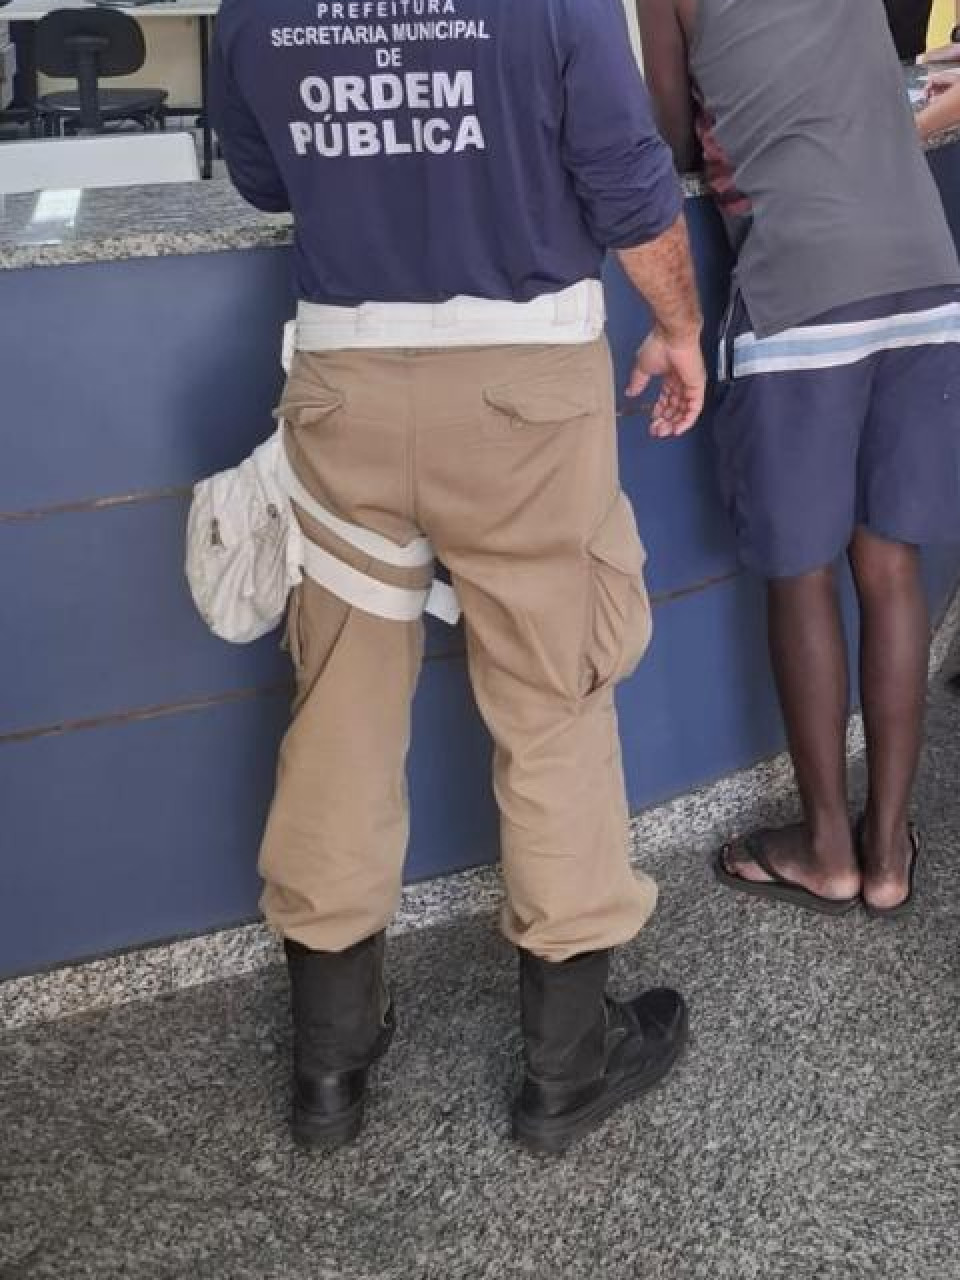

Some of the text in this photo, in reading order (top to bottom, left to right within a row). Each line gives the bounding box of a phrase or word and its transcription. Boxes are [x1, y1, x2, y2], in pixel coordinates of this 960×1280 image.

[270, 19, 491, 47] SECRETARIA MUNICIPAL
[375, 47, 403, 68] DE
[299, 70, 475, 113] ORDEM
[287, 113, 486, 157] PÚBLICA
